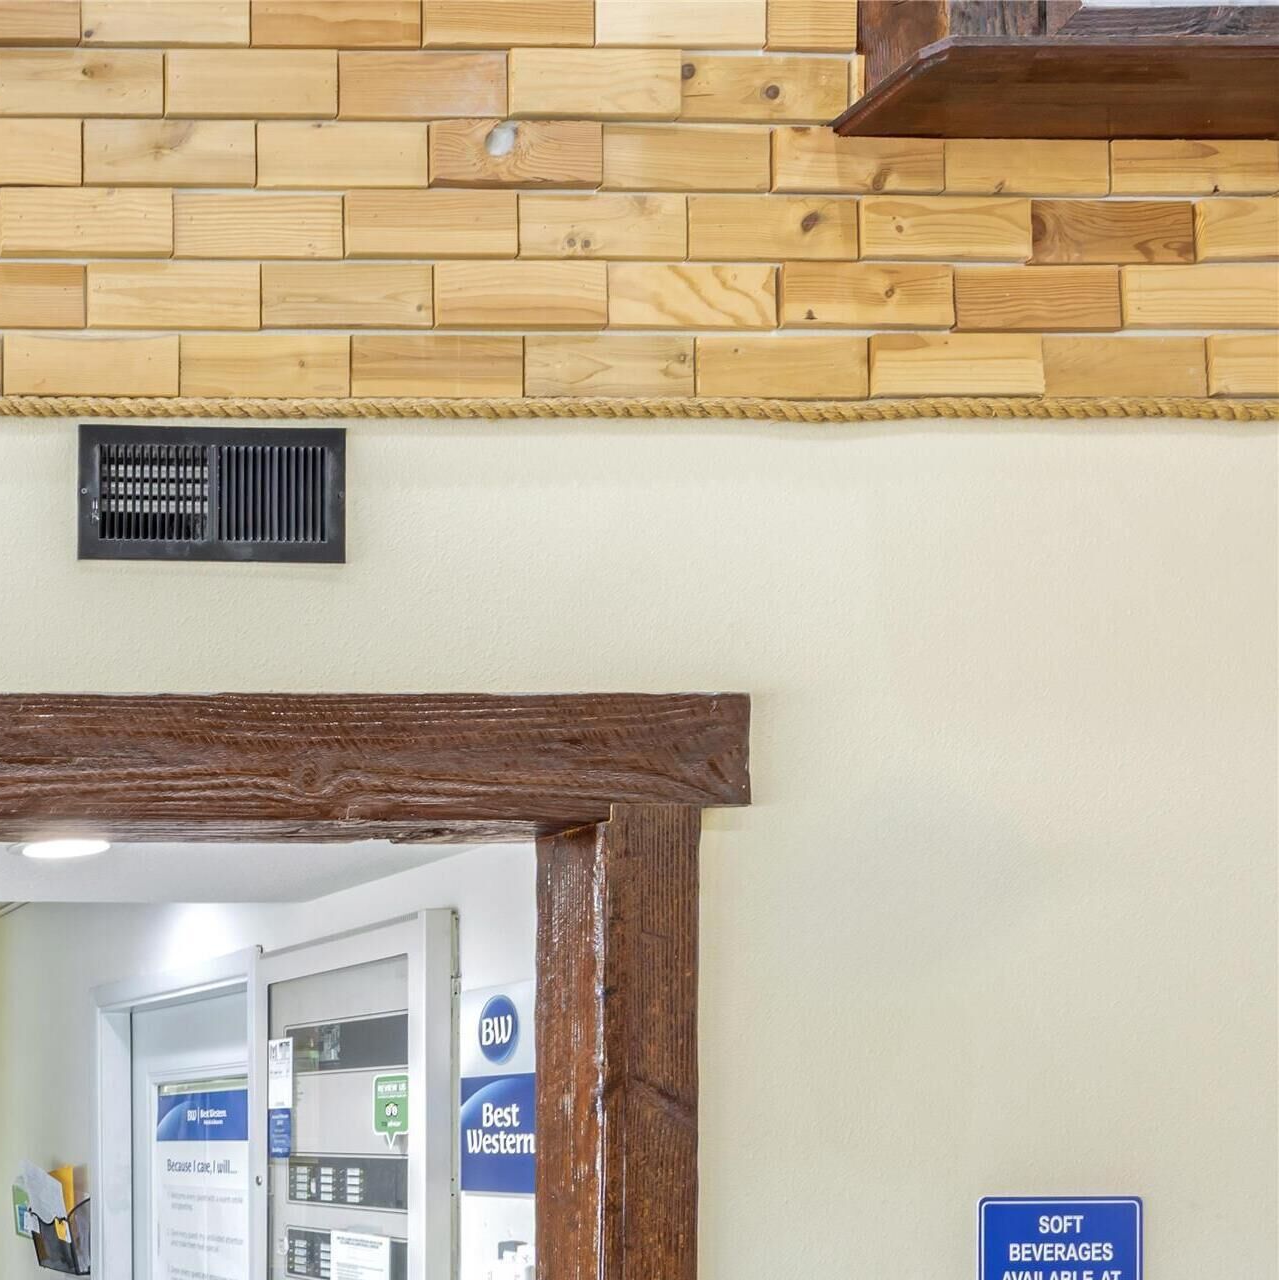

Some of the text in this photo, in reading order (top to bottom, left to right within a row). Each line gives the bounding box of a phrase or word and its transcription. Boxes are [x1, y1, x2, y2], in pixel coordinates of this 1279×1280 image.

[482, 1016, 512, 1046] BW
[482, 1103, 520, 1128] Best
[466, 1129, 536, 1154] Western
[167, 1158, 192, 1172] Because
[1038, 1216, 1084, 1234] SOFT
[1009, 1242, 1114, 1262] BEVERAGES
